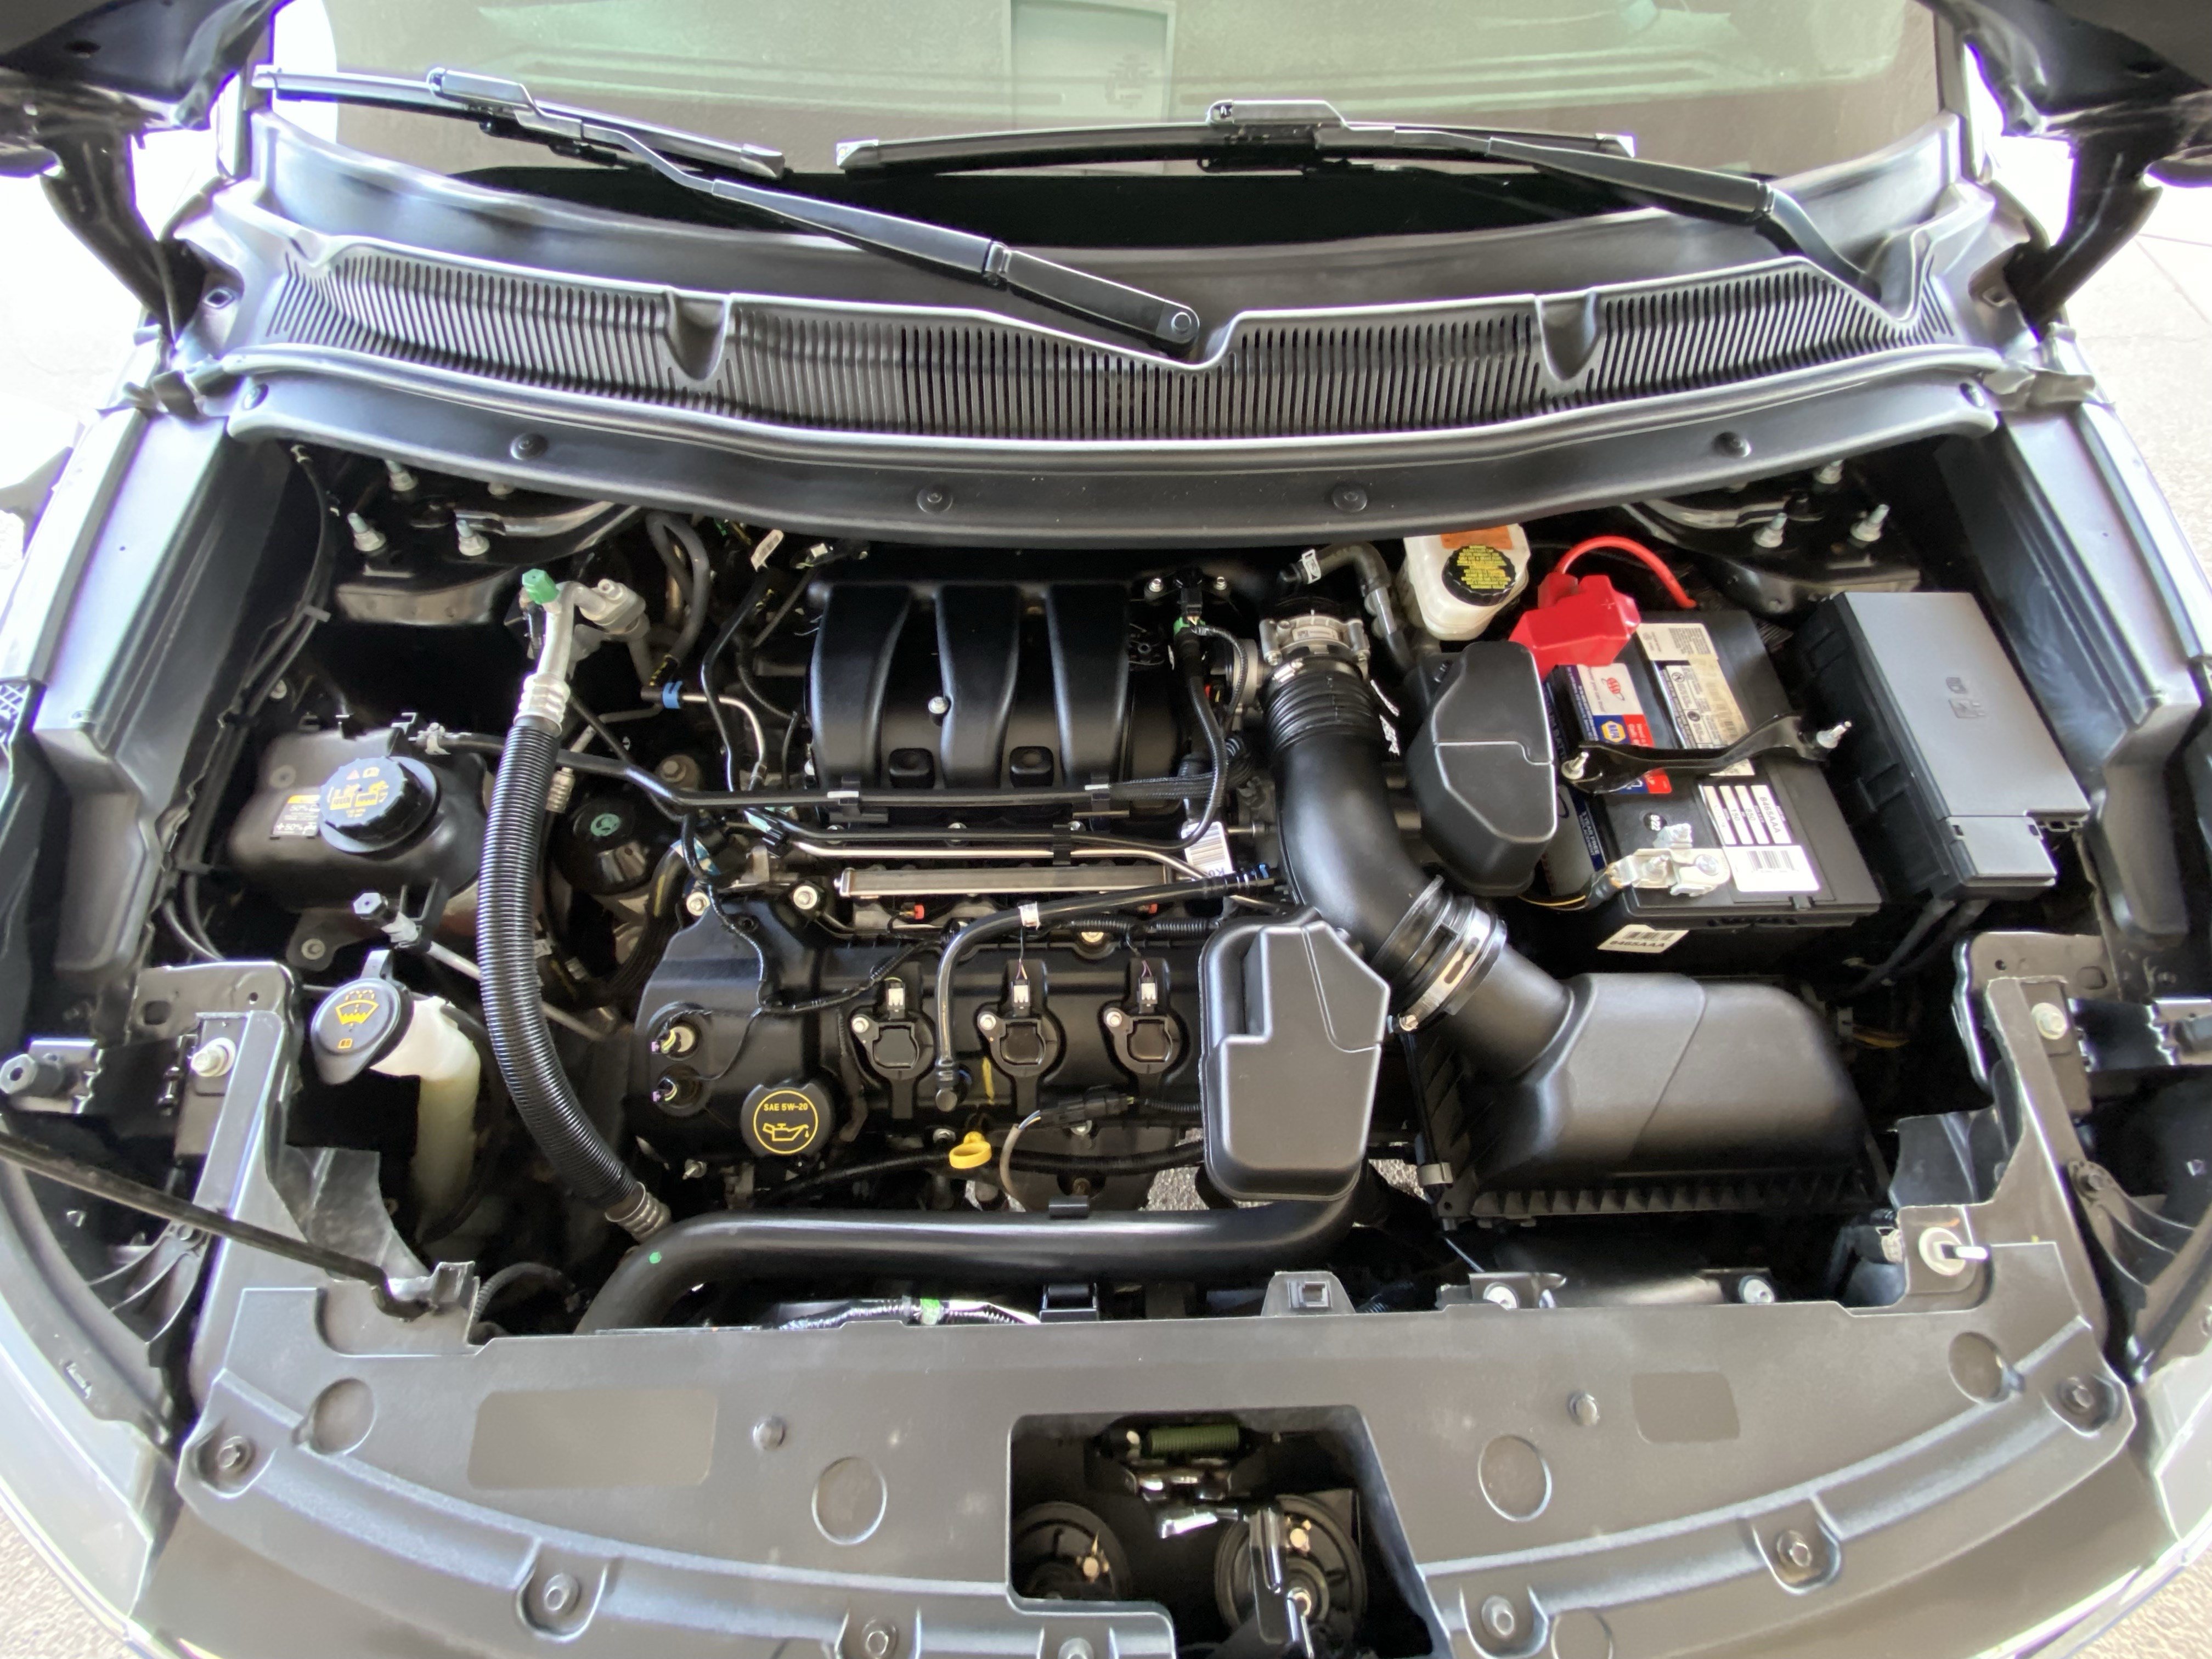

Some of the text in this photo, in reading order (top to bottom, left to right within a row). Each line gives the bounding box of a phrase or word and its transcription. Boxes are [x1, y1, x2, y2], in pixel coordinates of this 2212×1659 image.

[1607, 724, 1620, 740] NAPA
[1759, 797, 1781, 833] 8465AAA
[764, 1102, 808, 1111] SAE 5W-20
